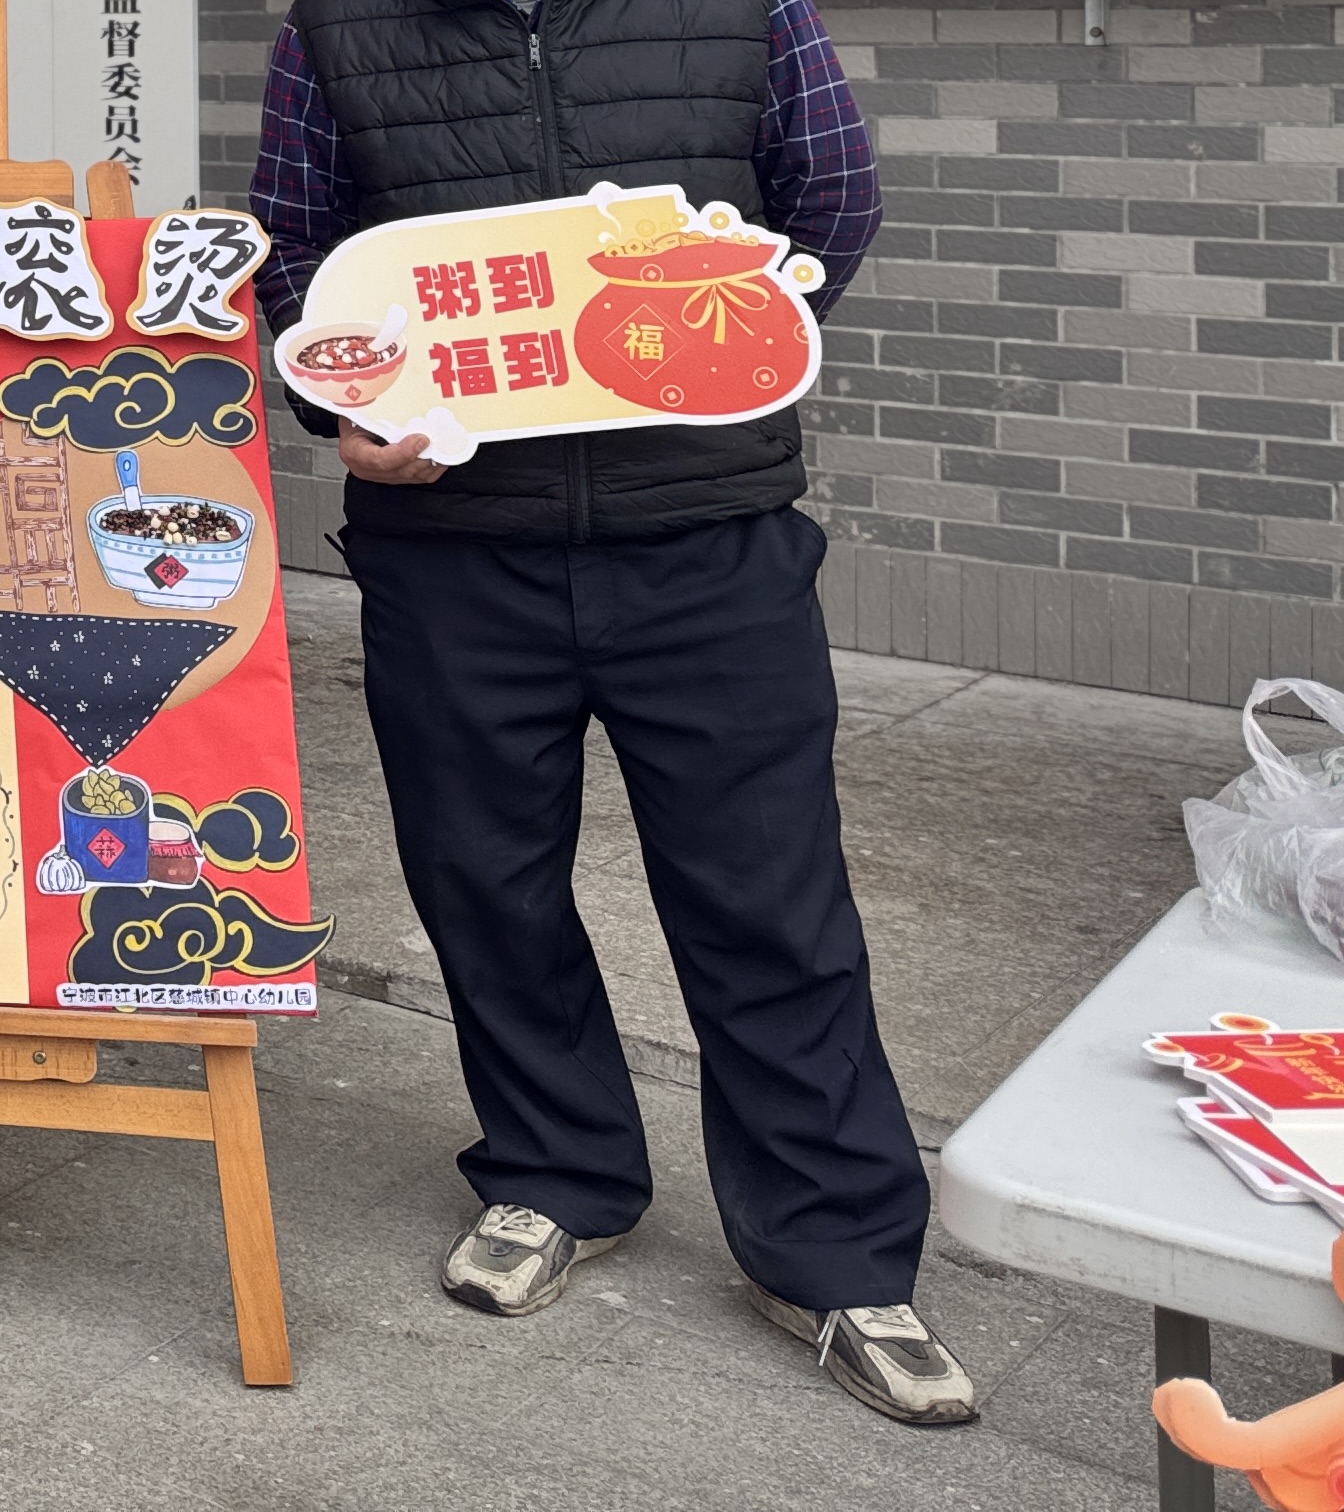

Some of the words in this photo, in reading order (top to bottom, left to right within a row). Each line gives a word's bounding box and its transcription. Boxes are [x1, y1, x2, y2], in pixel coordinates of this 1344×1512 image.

[410, 250, 556, 322] 粥到
[622, 321, 666, 362] 福
[429, 329, 571, 399] 福到
[161, 561, 181, 580] 粥
[61, 986, 313, 1009] 宁波市江北区慈城镇中心幼儿园
